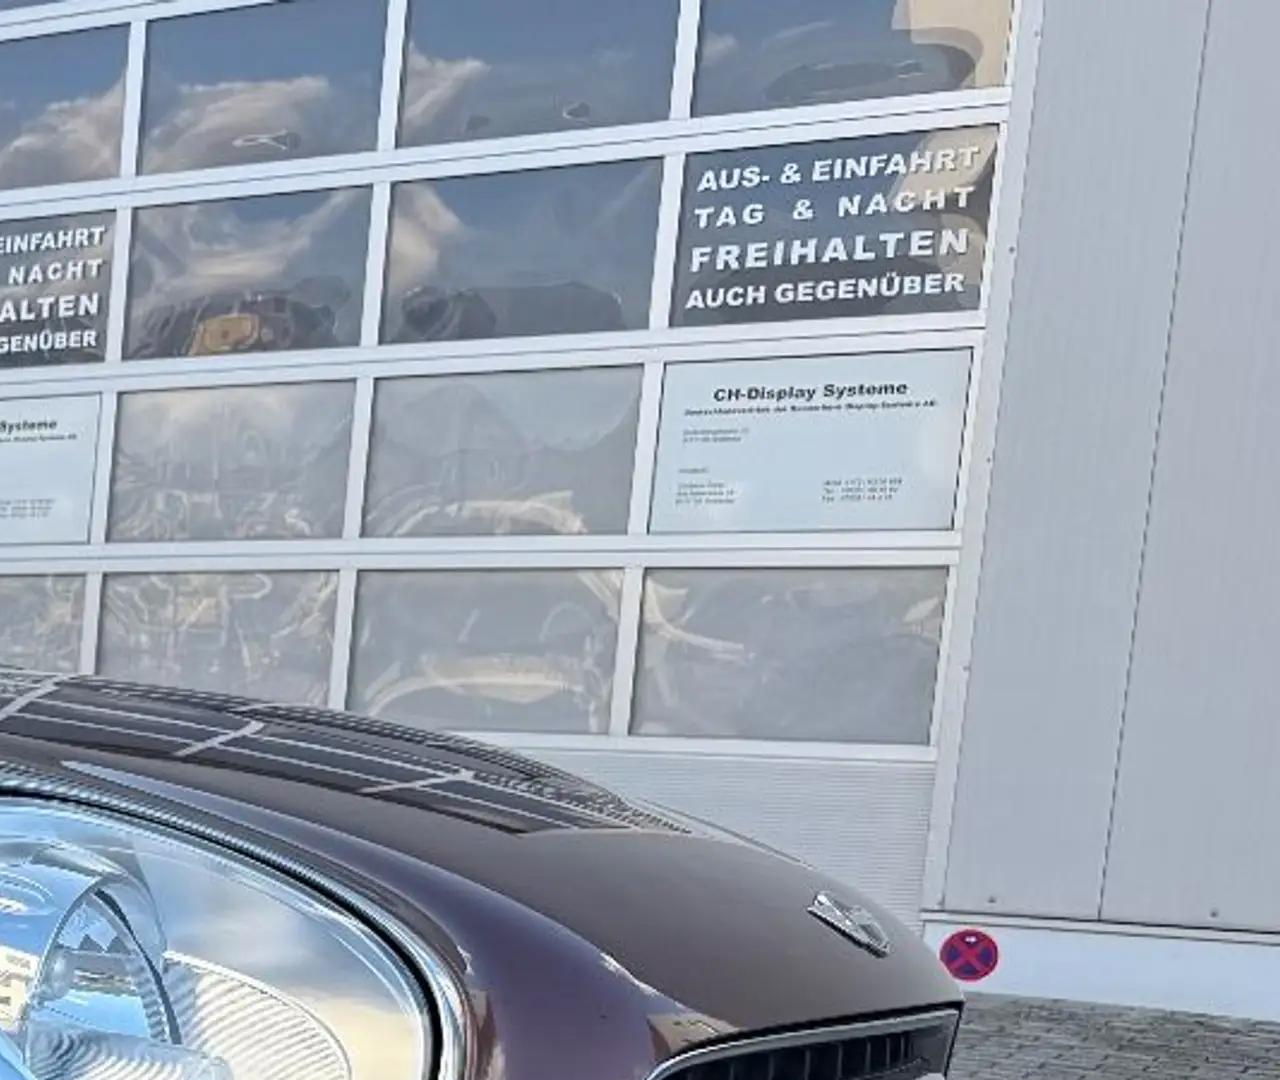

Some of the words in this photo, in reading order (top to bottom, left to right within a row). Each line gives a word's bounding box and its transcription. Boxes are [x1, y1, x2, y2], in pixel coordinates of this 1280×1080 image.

[696, 167, 769, 192] AUS-
[781, 163, 801, 185] &
[812, 146, 979, 182] EINFAHRT
[694, 206, 765, 229] TAG
[793, 199, 814, 221] &
[839, 186, 975, 218] NACHT
[690, 228, 969, 273] FREIHALTEN
[9, 259, 103, 284] NACHT
[685, 285, 766, 310] AUCH
[775, 272, 964, 303] GEGENÜBER
[713, 385, 816, 403] CH-Display
[824, 382, 908, 400] Systeme
[0, 418, 58, 435] Systeme
